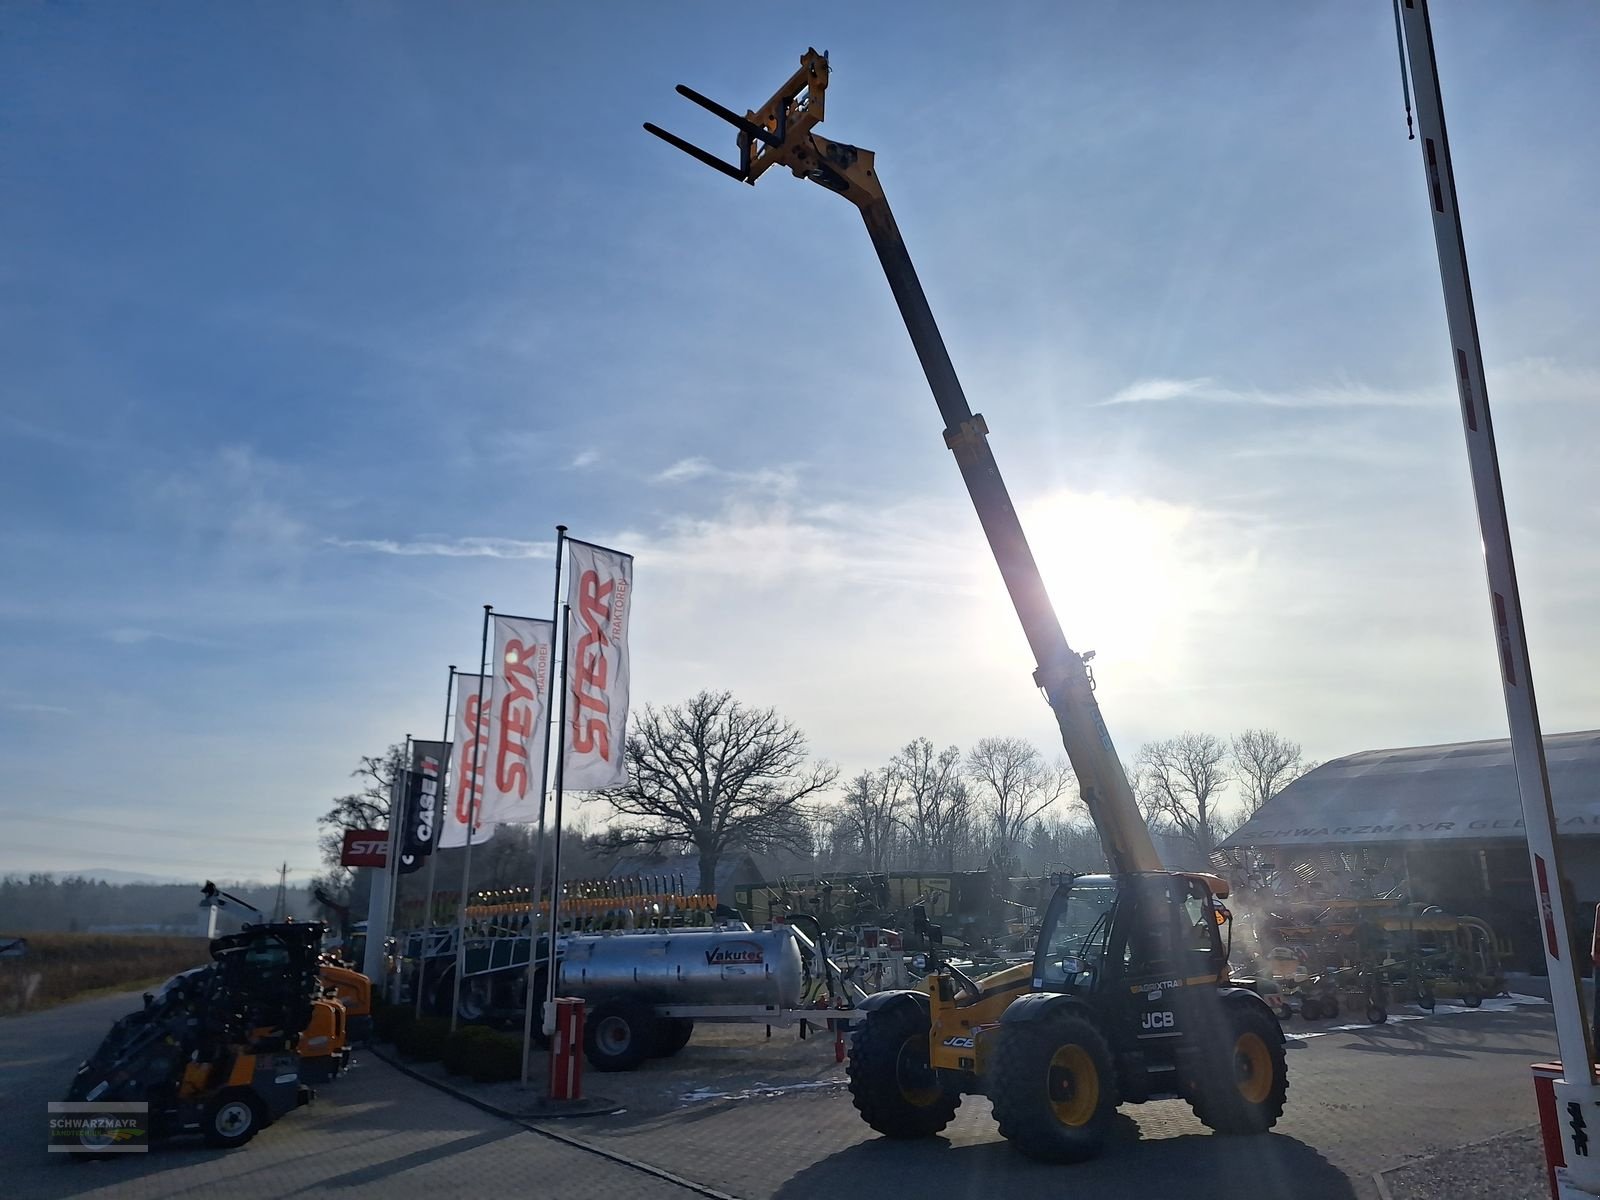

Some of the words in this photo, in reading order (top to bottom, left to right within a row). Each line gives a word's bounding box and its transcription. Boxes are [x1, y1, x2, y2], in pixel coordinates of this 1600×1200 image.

[612, 578, 627, 641] TRAKTOREN
[573, 570, 613, 762] STEYR
[496, 639, 536, 799] STEYR
[417, 778, 438, 841] CASE
[1242, 822, 1456, 840] SCHWARZMAYR
[705, 946, 764, 967] Vakutec
[1142, 1011, 1174, 1029] JCB
[943, 1036, 975, 1048] JCB
